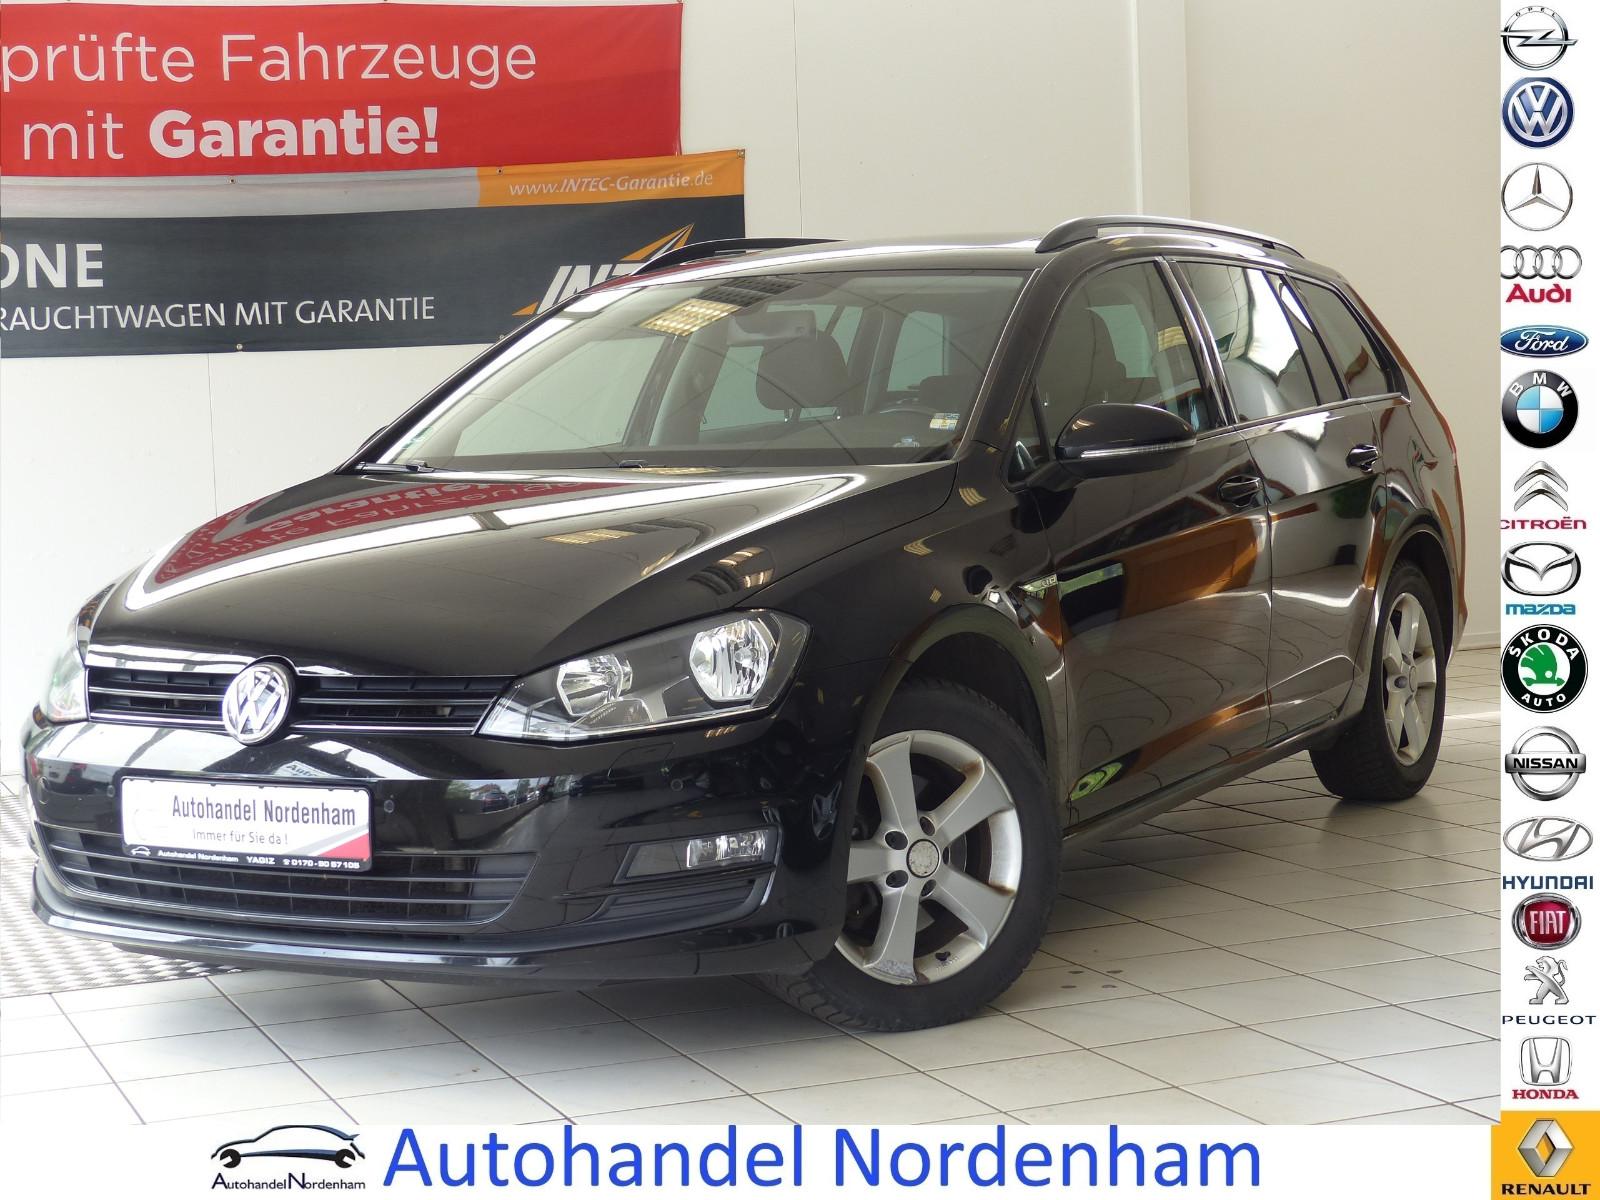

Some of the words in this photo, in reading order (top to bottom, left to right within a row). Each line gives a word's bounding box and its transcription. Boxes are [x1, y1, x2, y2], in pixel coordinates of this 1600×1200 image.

[2, 32, 195, 93] prüfte
[221, 32, 537, 90] Fahrzeuge
[22, 110, 124, 161] mit
[149, 105, 439, 159] Garantie!
[509, 169, 713, 196] www.INTEC-Garantie.de
[235, 301, 290, 327] MIT
[295, 297, 436, 324] GARANTIE
[172, 795, 256, 822] Autohandel
[264, 799, 356, 827] Nordenham
[249, 832, 265, 844] Sie
